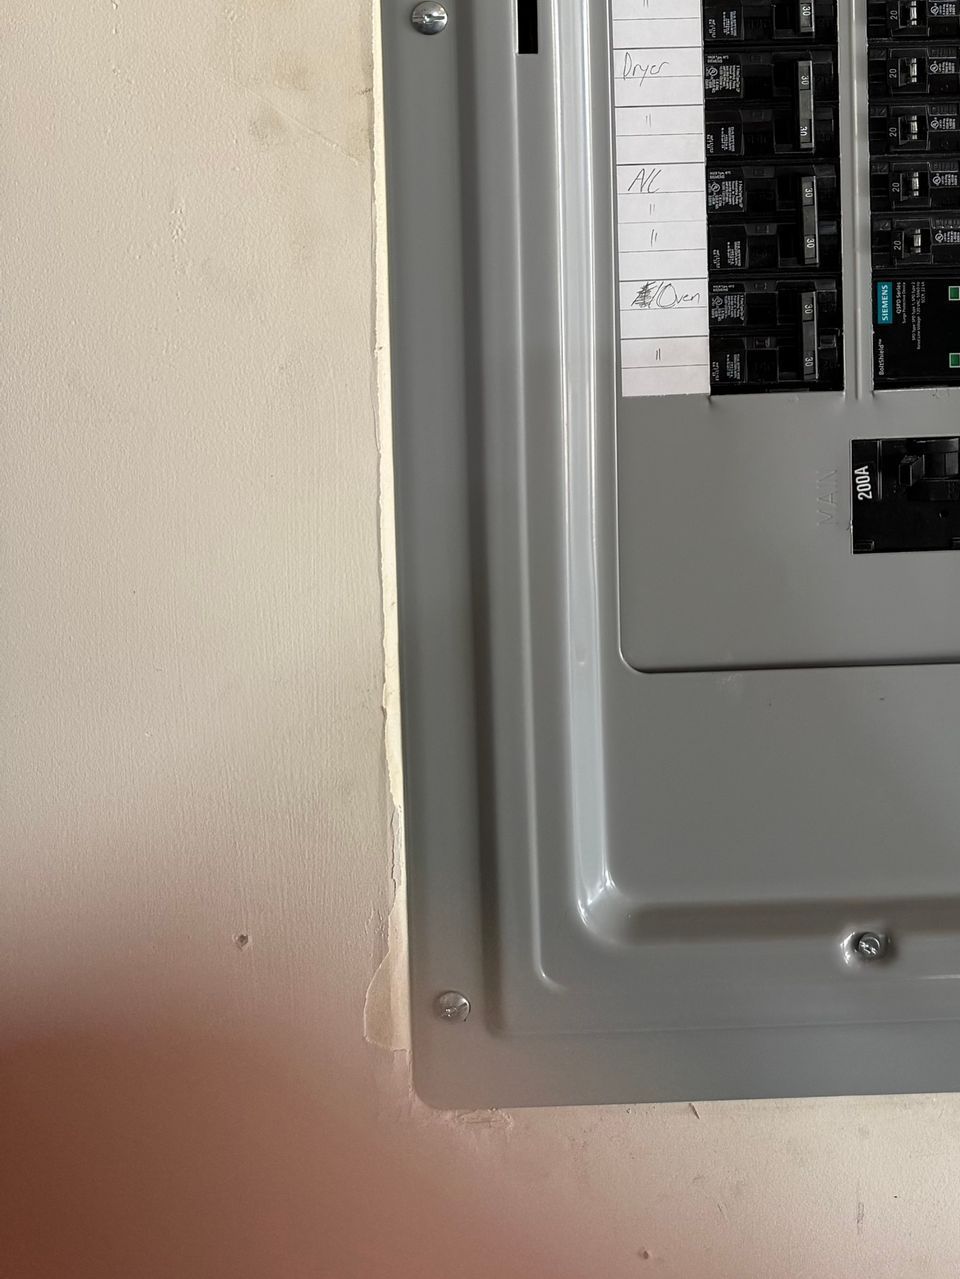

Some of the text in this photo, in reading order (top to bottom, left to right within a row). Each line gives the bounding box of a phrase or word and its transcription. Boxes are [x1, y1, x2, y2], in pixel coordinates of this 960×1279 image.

[802, 6, 811, 17] 30
[890, 10, 898, 20] 20
[622, 51, 669, 87] Dryer
[889, 68, 897, 78] 20
[801, 75, 810, 86] 30
[800, 126, 808, 137] 30
[889, 127, 897, 137] 20
[892, 182, 900, 193] 20
[804, 188, 813, 199] 30
[806, 238, 815, 250] 30
[894, 240, 902, 250] 20
[881, 284, 889, 321] SIEMENS
[805, 303, 812, 314] 30
[804, 356, 813, 367] 30
[854, 464, 873, 501] 200A
